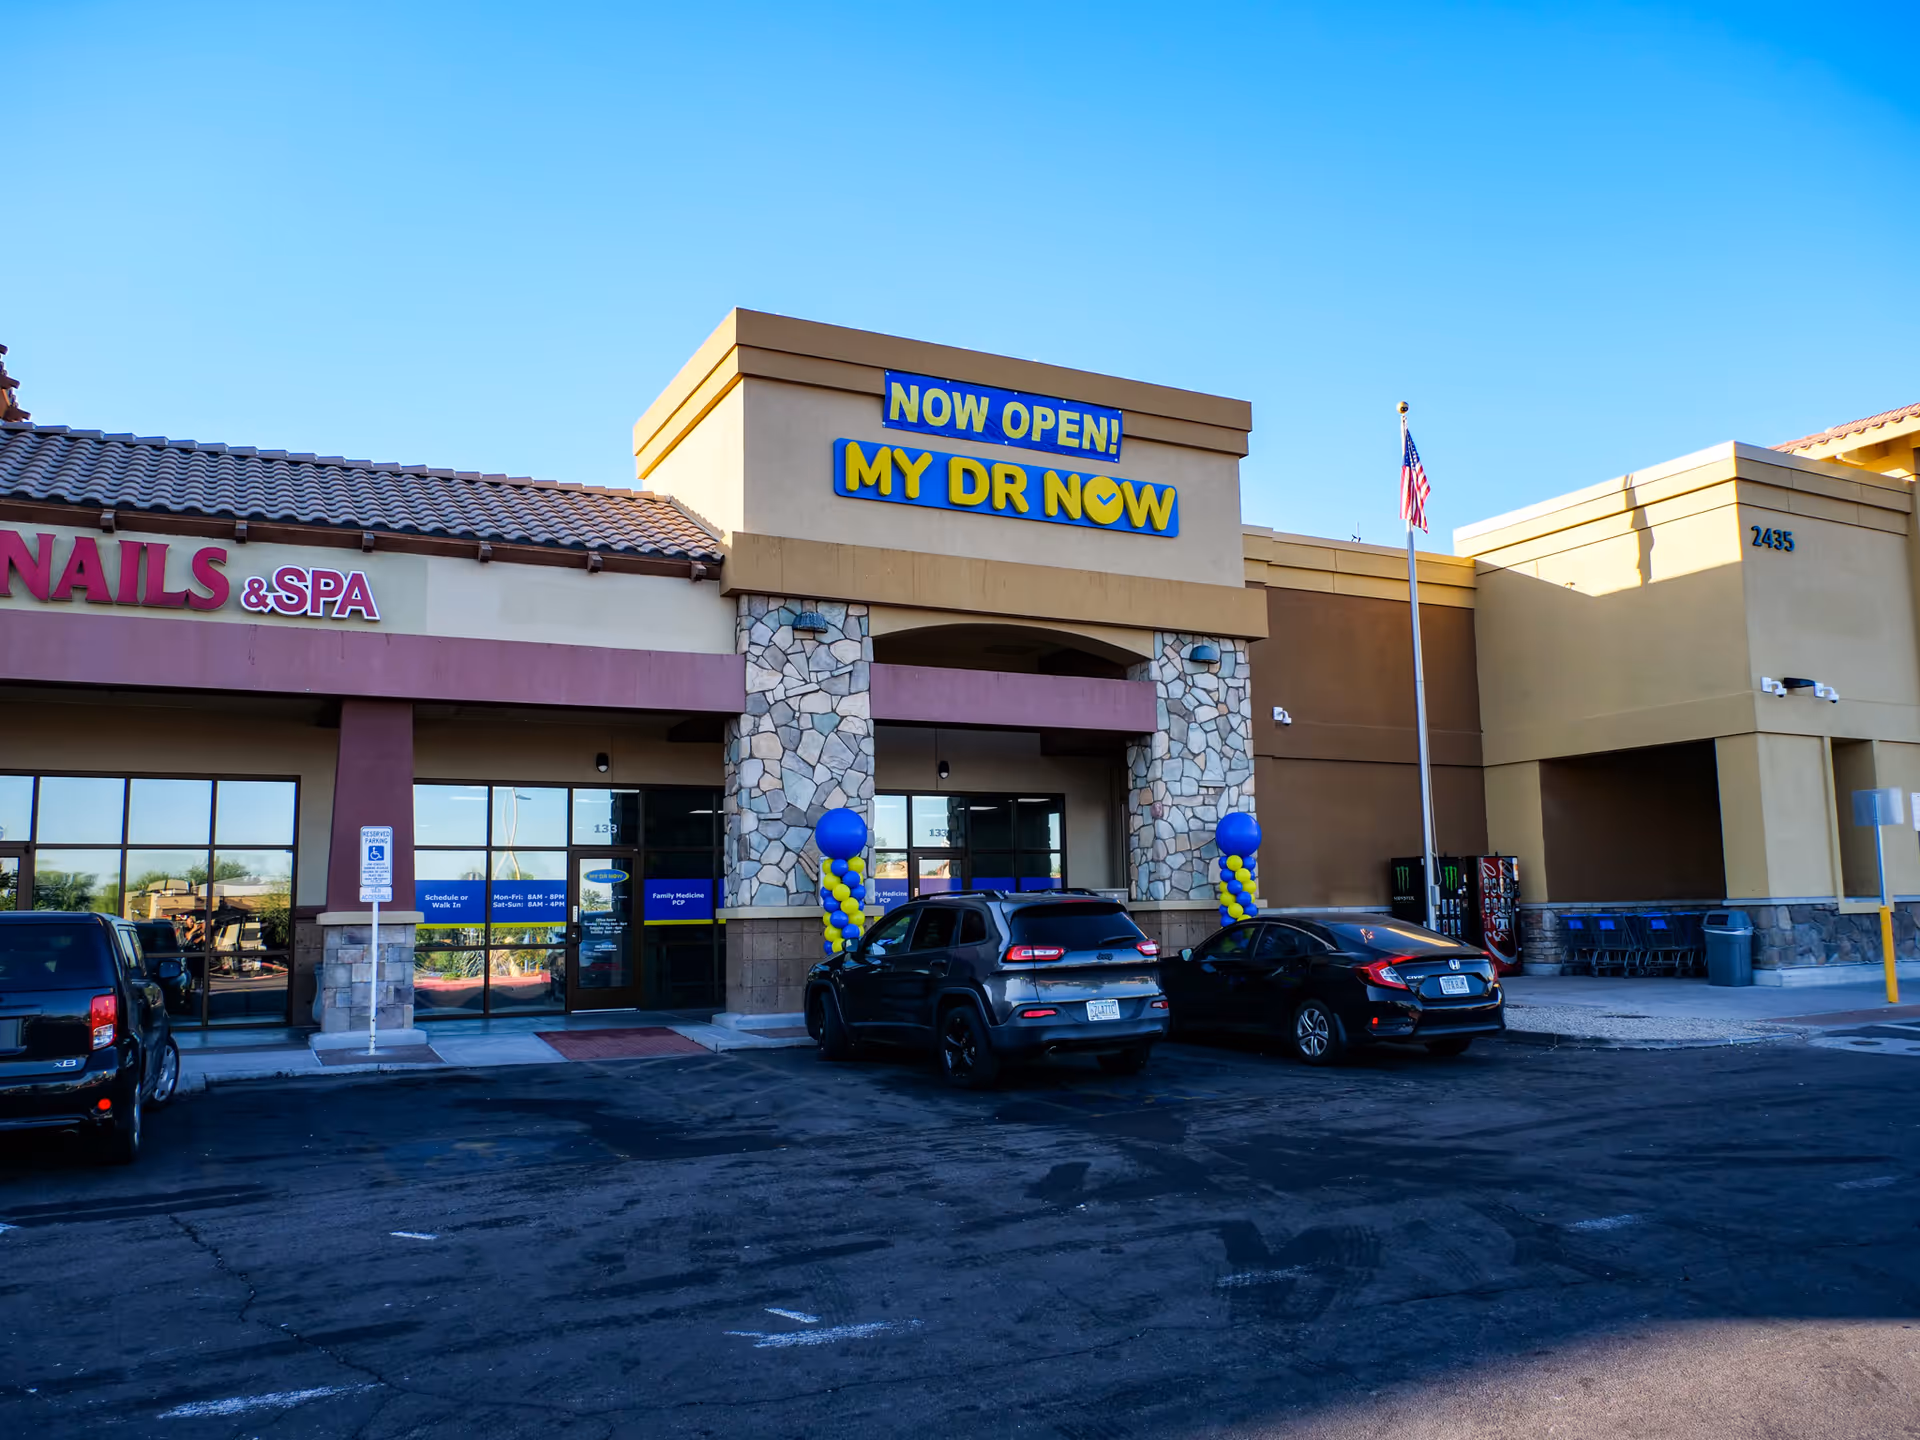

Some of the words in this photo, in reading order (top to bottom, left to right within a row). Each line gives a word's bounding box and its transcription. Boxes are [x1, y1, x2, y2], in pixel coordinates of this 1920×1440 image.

[889, 382, 989, 433] NOW
[1002, 401, 1119, 454] OPEN!
[845, 441, 933, 500] MY
[948, 456, 1029, 514] DR
[1043, 469, 1176, 531] NOW
[1751, 525, 1795, 552] 2435
[0, 529, 230, 611] NAILS
[594, 824, 618, 833] 133
[53, 1059, 77, 1068] xB
